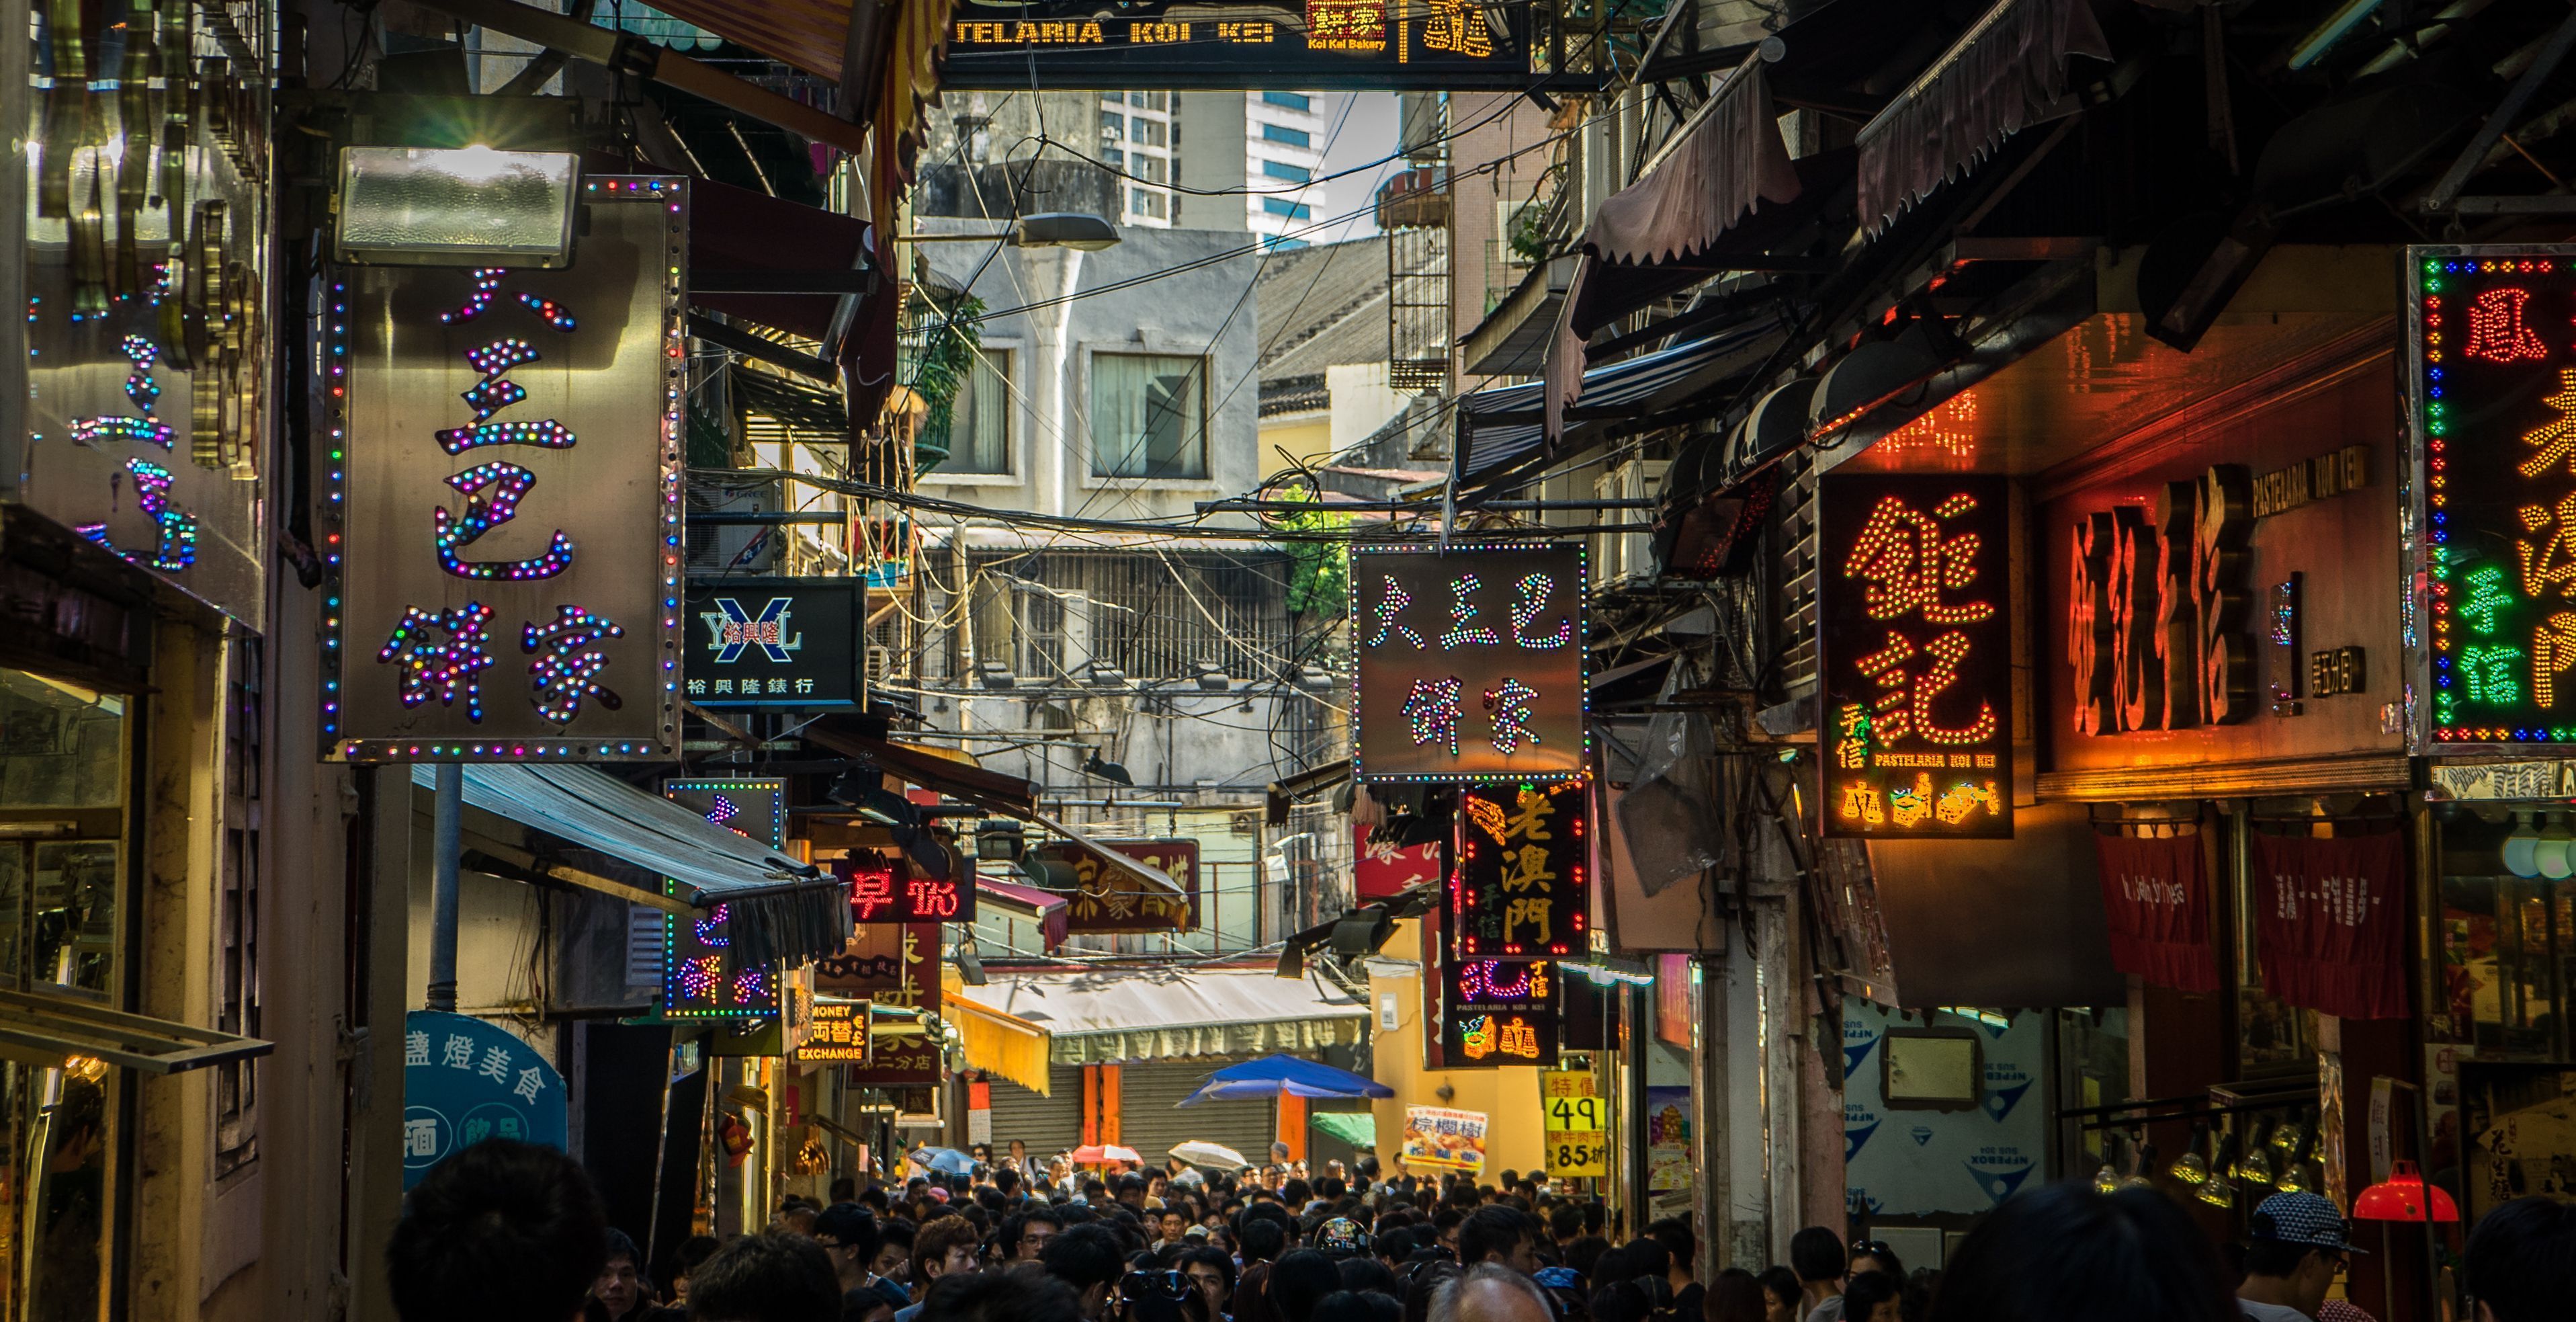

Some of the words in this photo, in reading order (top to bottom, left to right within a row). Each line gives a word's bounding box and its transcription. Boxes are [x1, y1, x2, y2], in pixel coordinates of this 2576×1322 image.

[1130, 22, 1191, 43] KOI
[1217, 22, 1274, 43] KEI
[1308, 38, 1326, 49] Koi
[1328, 38, 1346, 49] Kei
[1348, 38, 1386, 51] Bakery
[1367, 572, 1571, 651] 大三巴
[1843, 493, 1996, 748] 鉅記
[723, 621, 779, 645] 裕興隆
[2459, 568, 2520, 703] 手信
[377, 602, 625, 725] 餅家
[687, 678, 814, 695] 裕興隆錶行
[1400, 674, 1541, 755] 餅家
[1836, 703, 1865, 770] 手信
[1875, 754, 1944, 768] PASTELARIA
[1950, 754, 1971, 768] KOI
[1975, 754, 1996, 768] KEI
[1501, 790, 1556, 944] 老澳門
[1479, 884, 1502, 940] 手信
[812, 1005, 851, 1018] MONEY
[1457, 1003, 1507, 1011] PASTELARIA
[798, 1048, 863, 1061] EXCHANGE
[1552, 1098, 1596, 1130] 49
[1971, 1156, 2028, 1164] NFPEBOX
